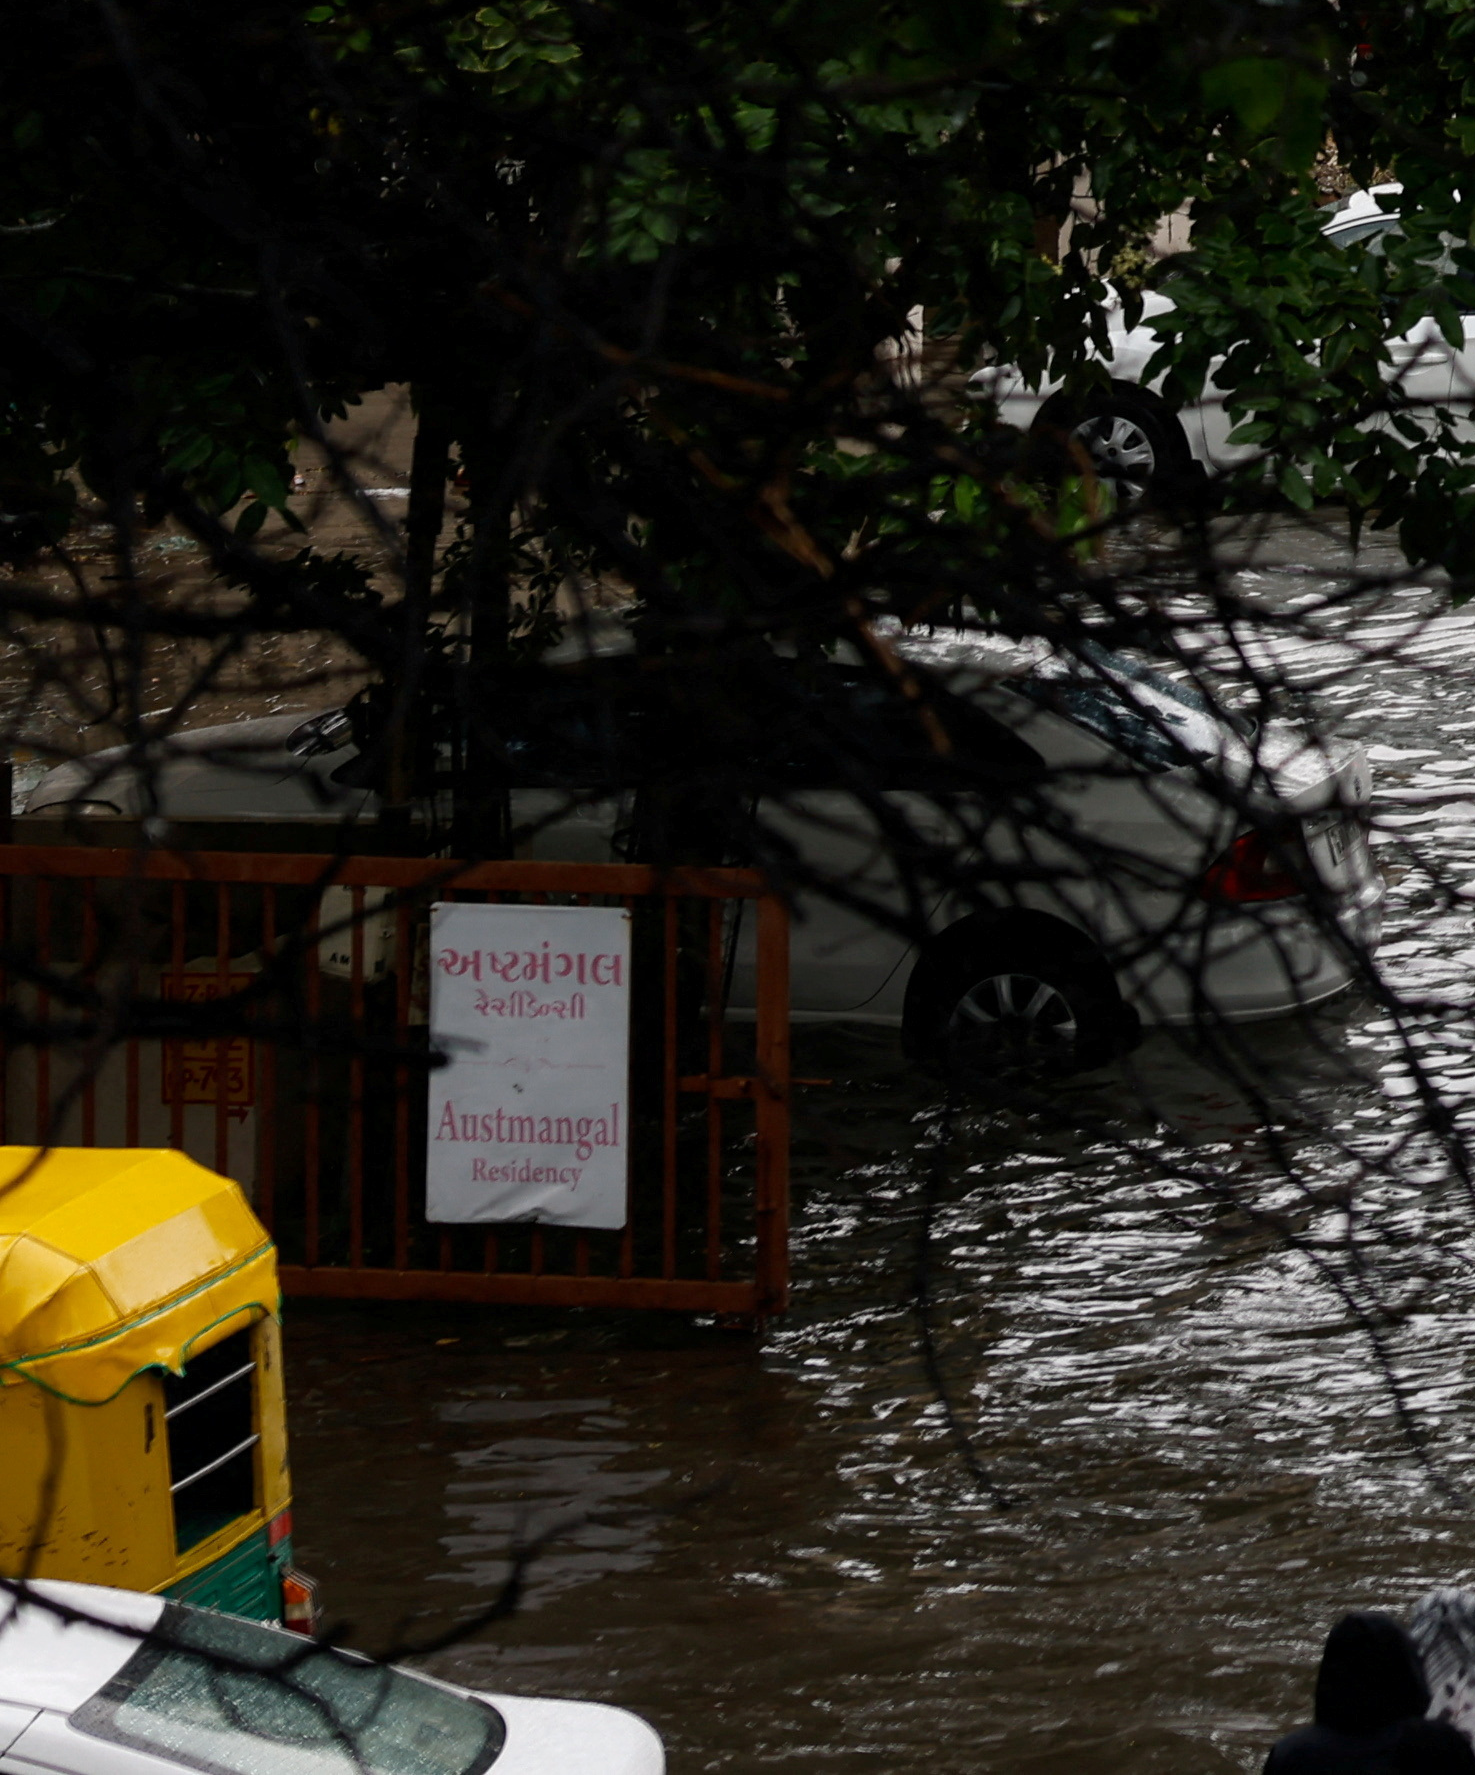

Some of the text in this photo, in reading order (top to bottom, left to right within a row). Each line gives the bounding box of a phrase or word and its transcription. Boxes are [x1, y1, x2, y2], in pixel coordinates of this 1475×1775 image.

[437, 941, 622, 986] અષ્ટમંગલ
[435, 1100, 620, 1161] Austmangal
[472, 1157, 583, 1192] Residency
